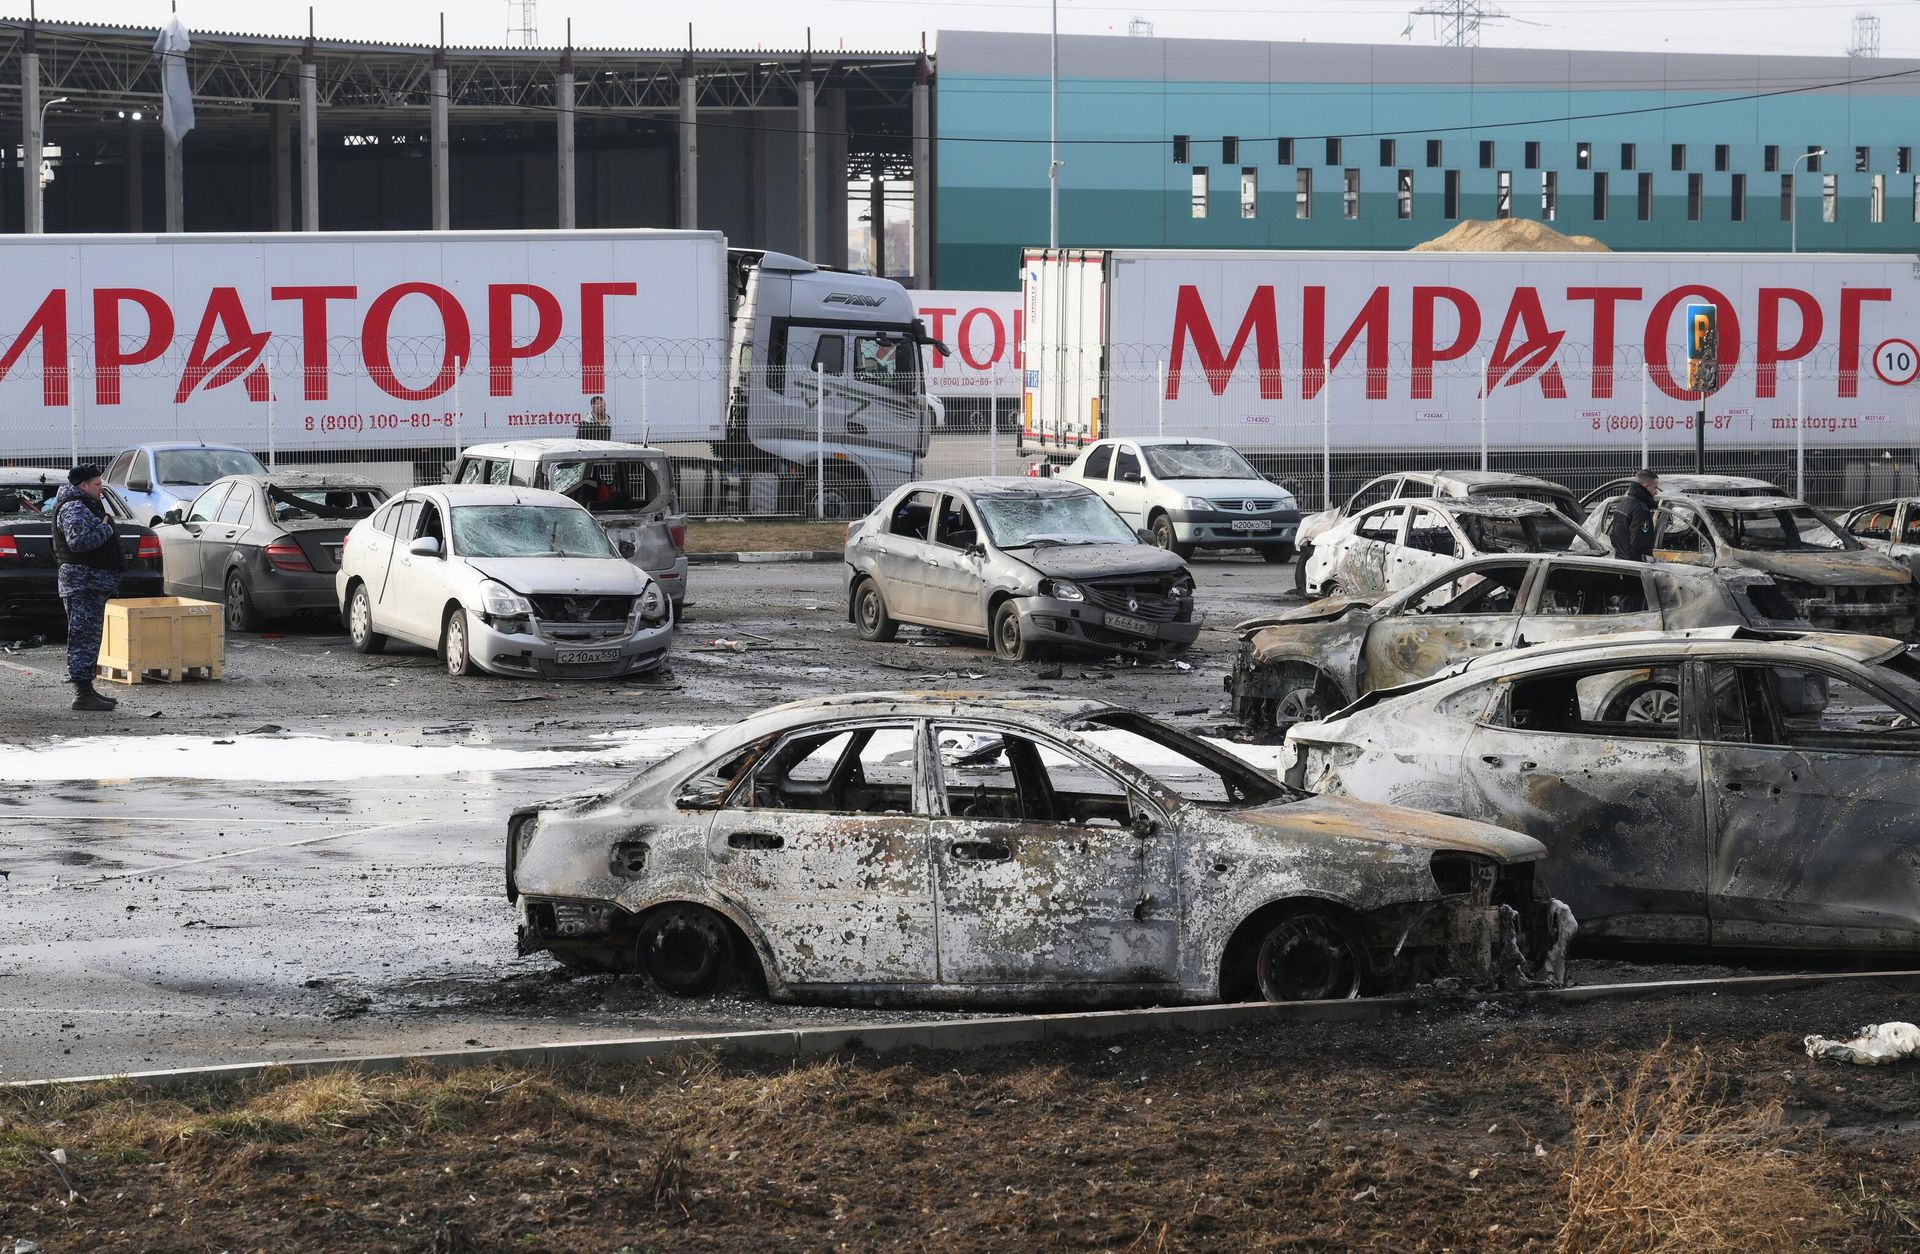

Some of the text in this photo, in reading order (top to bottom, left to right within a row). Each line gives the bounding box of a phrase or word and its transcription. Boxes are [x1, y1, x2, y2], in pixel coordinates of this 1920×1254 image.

[822, 292, 887, 307] FAW
[918, 307, 1022, 370] ТО
[1694, 314, 1710, 351] P
[1167, 284, 1892, 401] МИРАТОРГ
[1885, 352, 1910, 371] 10
[1026, 370, 1039, 388] TIR
[304, 415, 315, 431] 8
[320, 413, 364, 433] (800)
[1592, 417, 1601, 430] 8
[1606, 414, 1643, 433] (800)
[1648, 415, 1732, 430] 100-8-87
